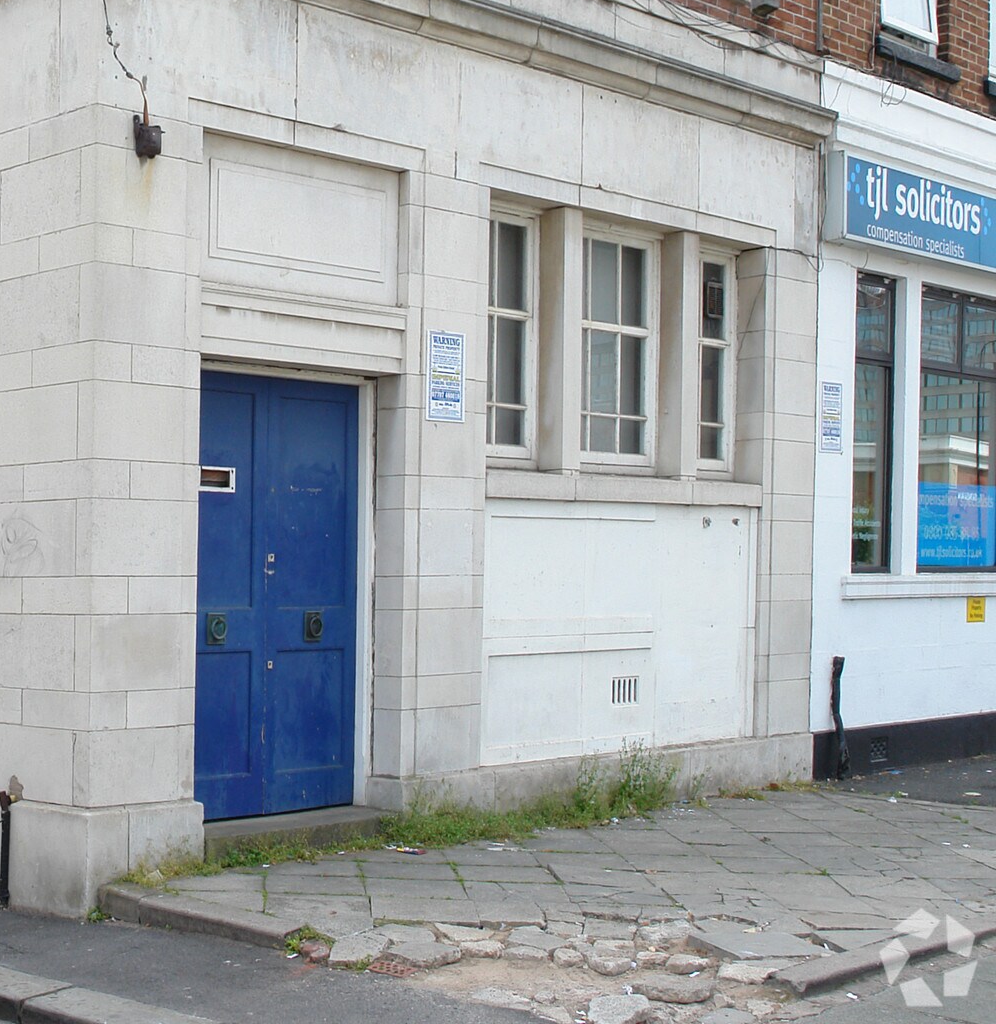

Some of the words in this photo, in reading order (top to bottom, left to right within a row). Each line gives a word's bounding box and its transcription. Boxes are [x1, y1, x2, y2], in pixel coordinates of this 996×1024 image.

[866, 166, 888, 220] tjl
[895, 178, 981, 235] solicitors
[866, 224, 923, 249] compensation
[925, 237, 965, 259] specialists
[433, 336, 460, 346] WARNING
